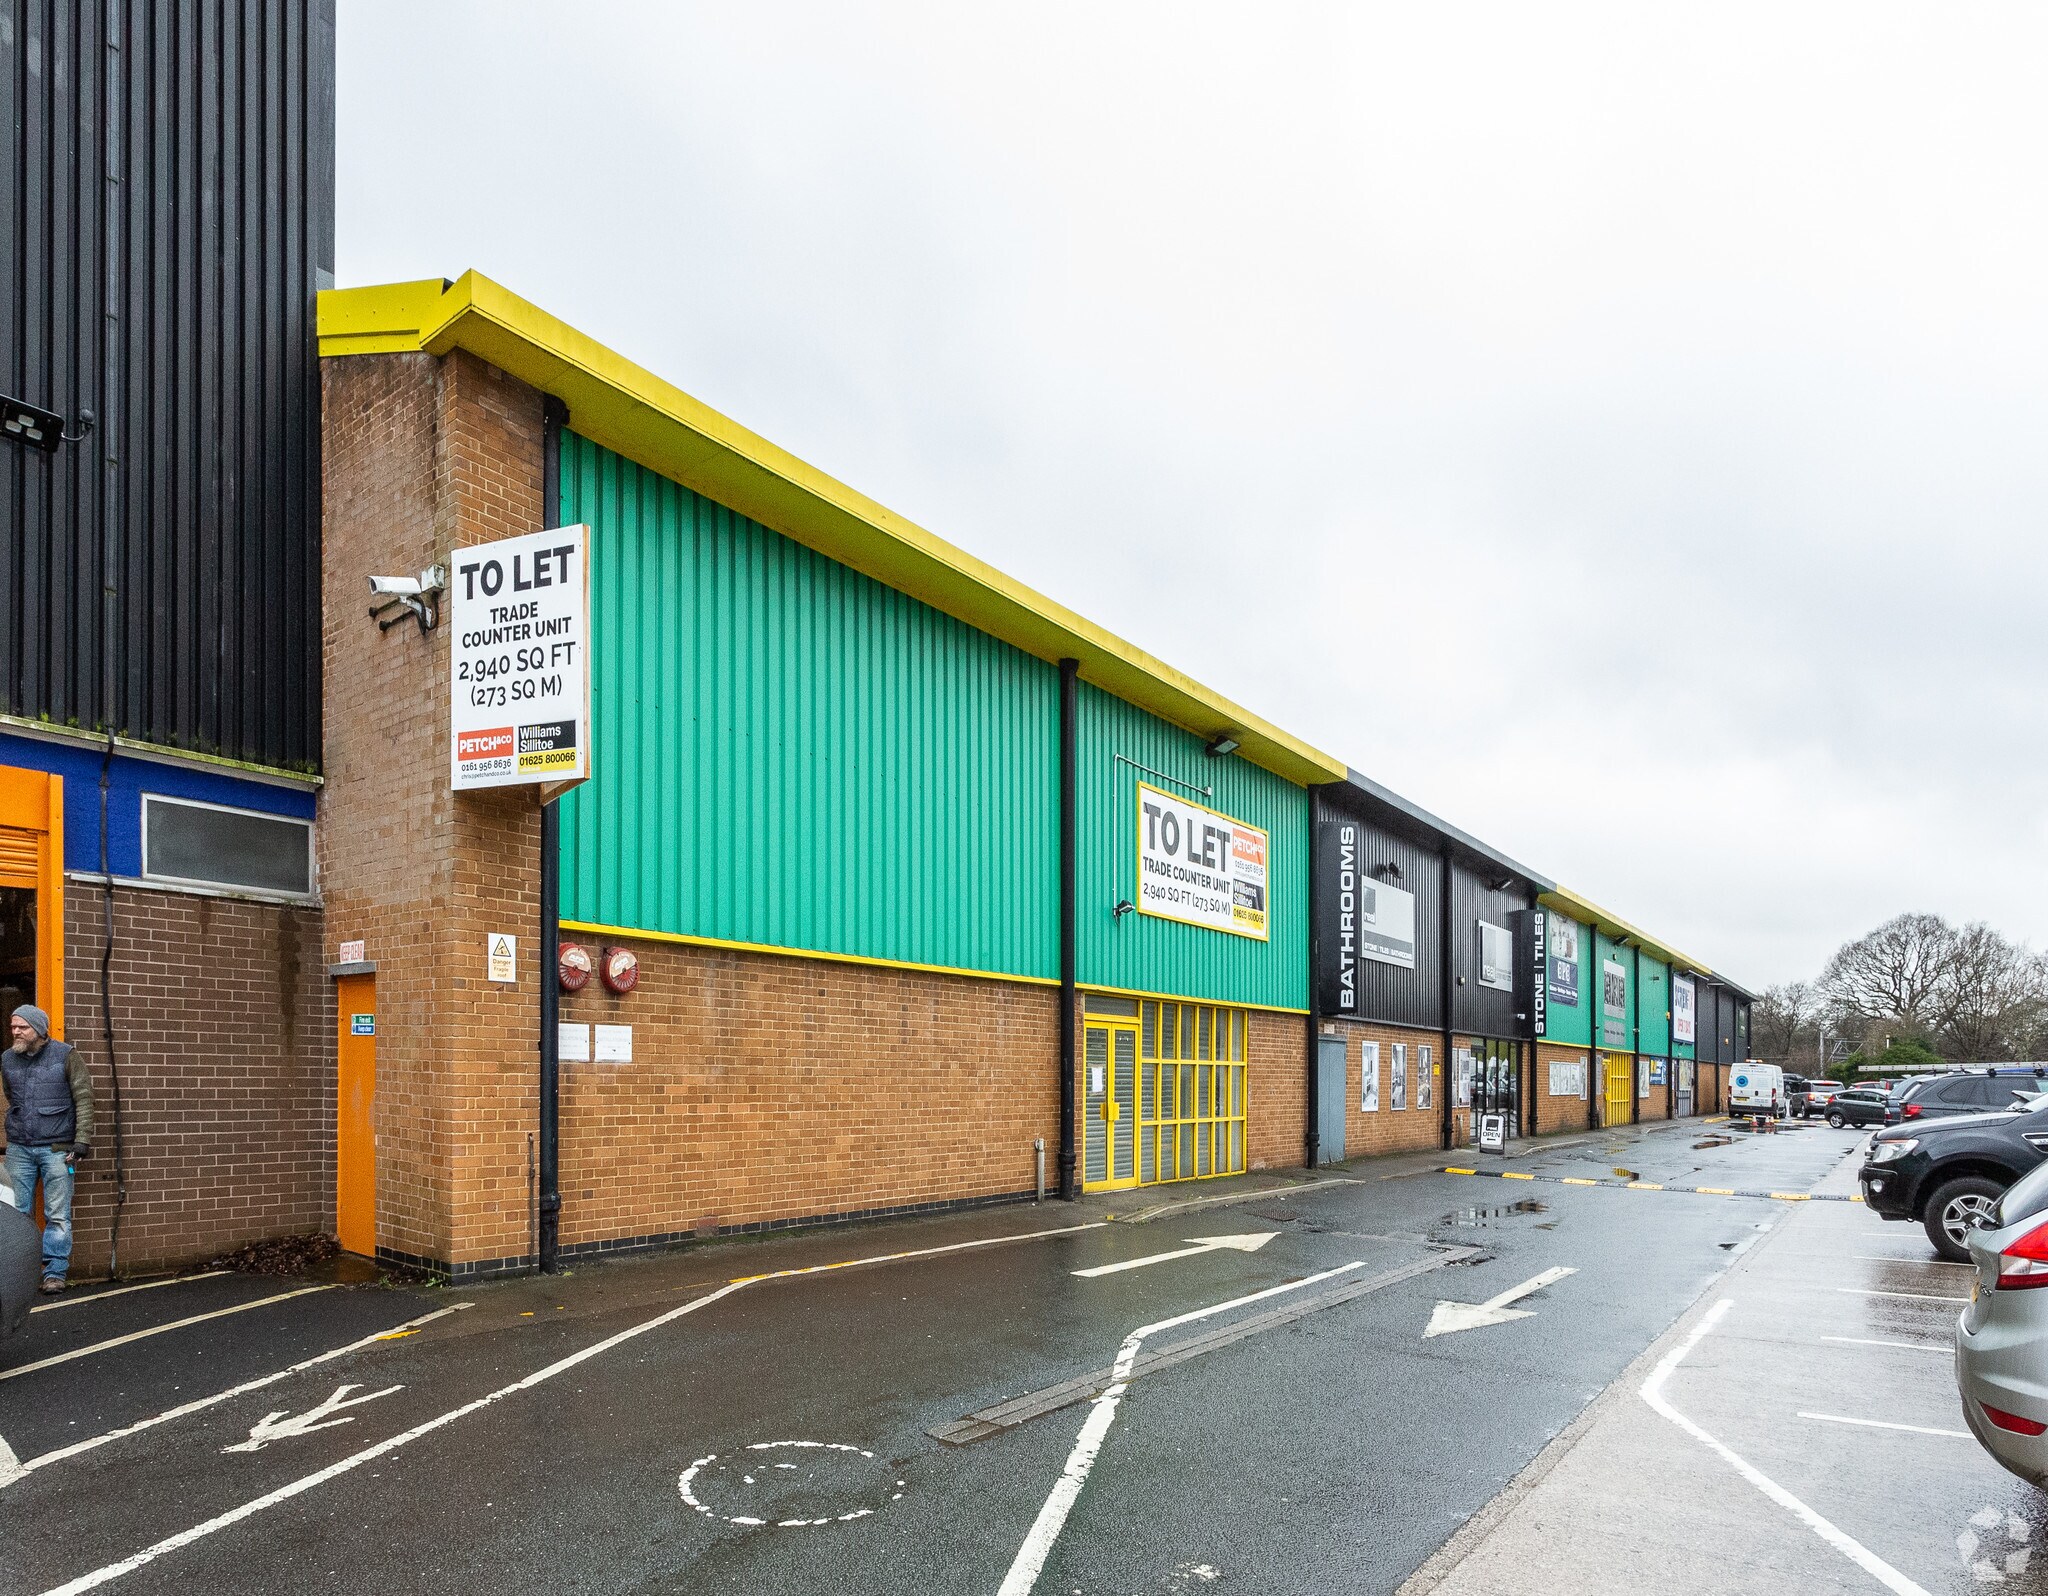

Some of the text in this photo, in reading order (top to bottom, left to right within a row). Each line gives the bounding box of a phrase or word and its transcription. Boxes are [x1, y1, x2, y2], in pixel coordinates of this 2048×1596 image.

[460, 544, 574, 600] TO LET
[490, 601, 538, 624] TRADE
[462, 616, 572, 649] COUNTER UNIT
[459, 641, 576, 683] 2,940 SQ FT
[470, 674, 562, 707] (273 SQ M)
[519, 726, 561, 739] Williams
[520, 739, 554, 752] Sillitoe
[461, 762, 477, 772] 0161
[479, 760, 492, 771] 956
[493, 759, 512, 769] 8636
[519, 752, 576, 766] 01625 800066
[1143, 802, 1230, 872] TO LET
[1143, 856, 1171, 878] TRADE
[1173, 867, 1211, 889] COUNTER
[1213, 879, 1230, 895] UNIT
[1143, 883, 1231, 917] 2,940 SQ FT (273 SQ M)
[1233, 880, 1257, 898] Williams
[1340, 826, 1354, 1008] BATHROOMS
[1364, 912, 1375, 924] real
[351, 943, 363, 960] CLEAR
[1364, 942, 1377, 952] STONE
[492, 958, 511, 966] Danger
[1534, 912, 1544, 1035] STONE TILES
